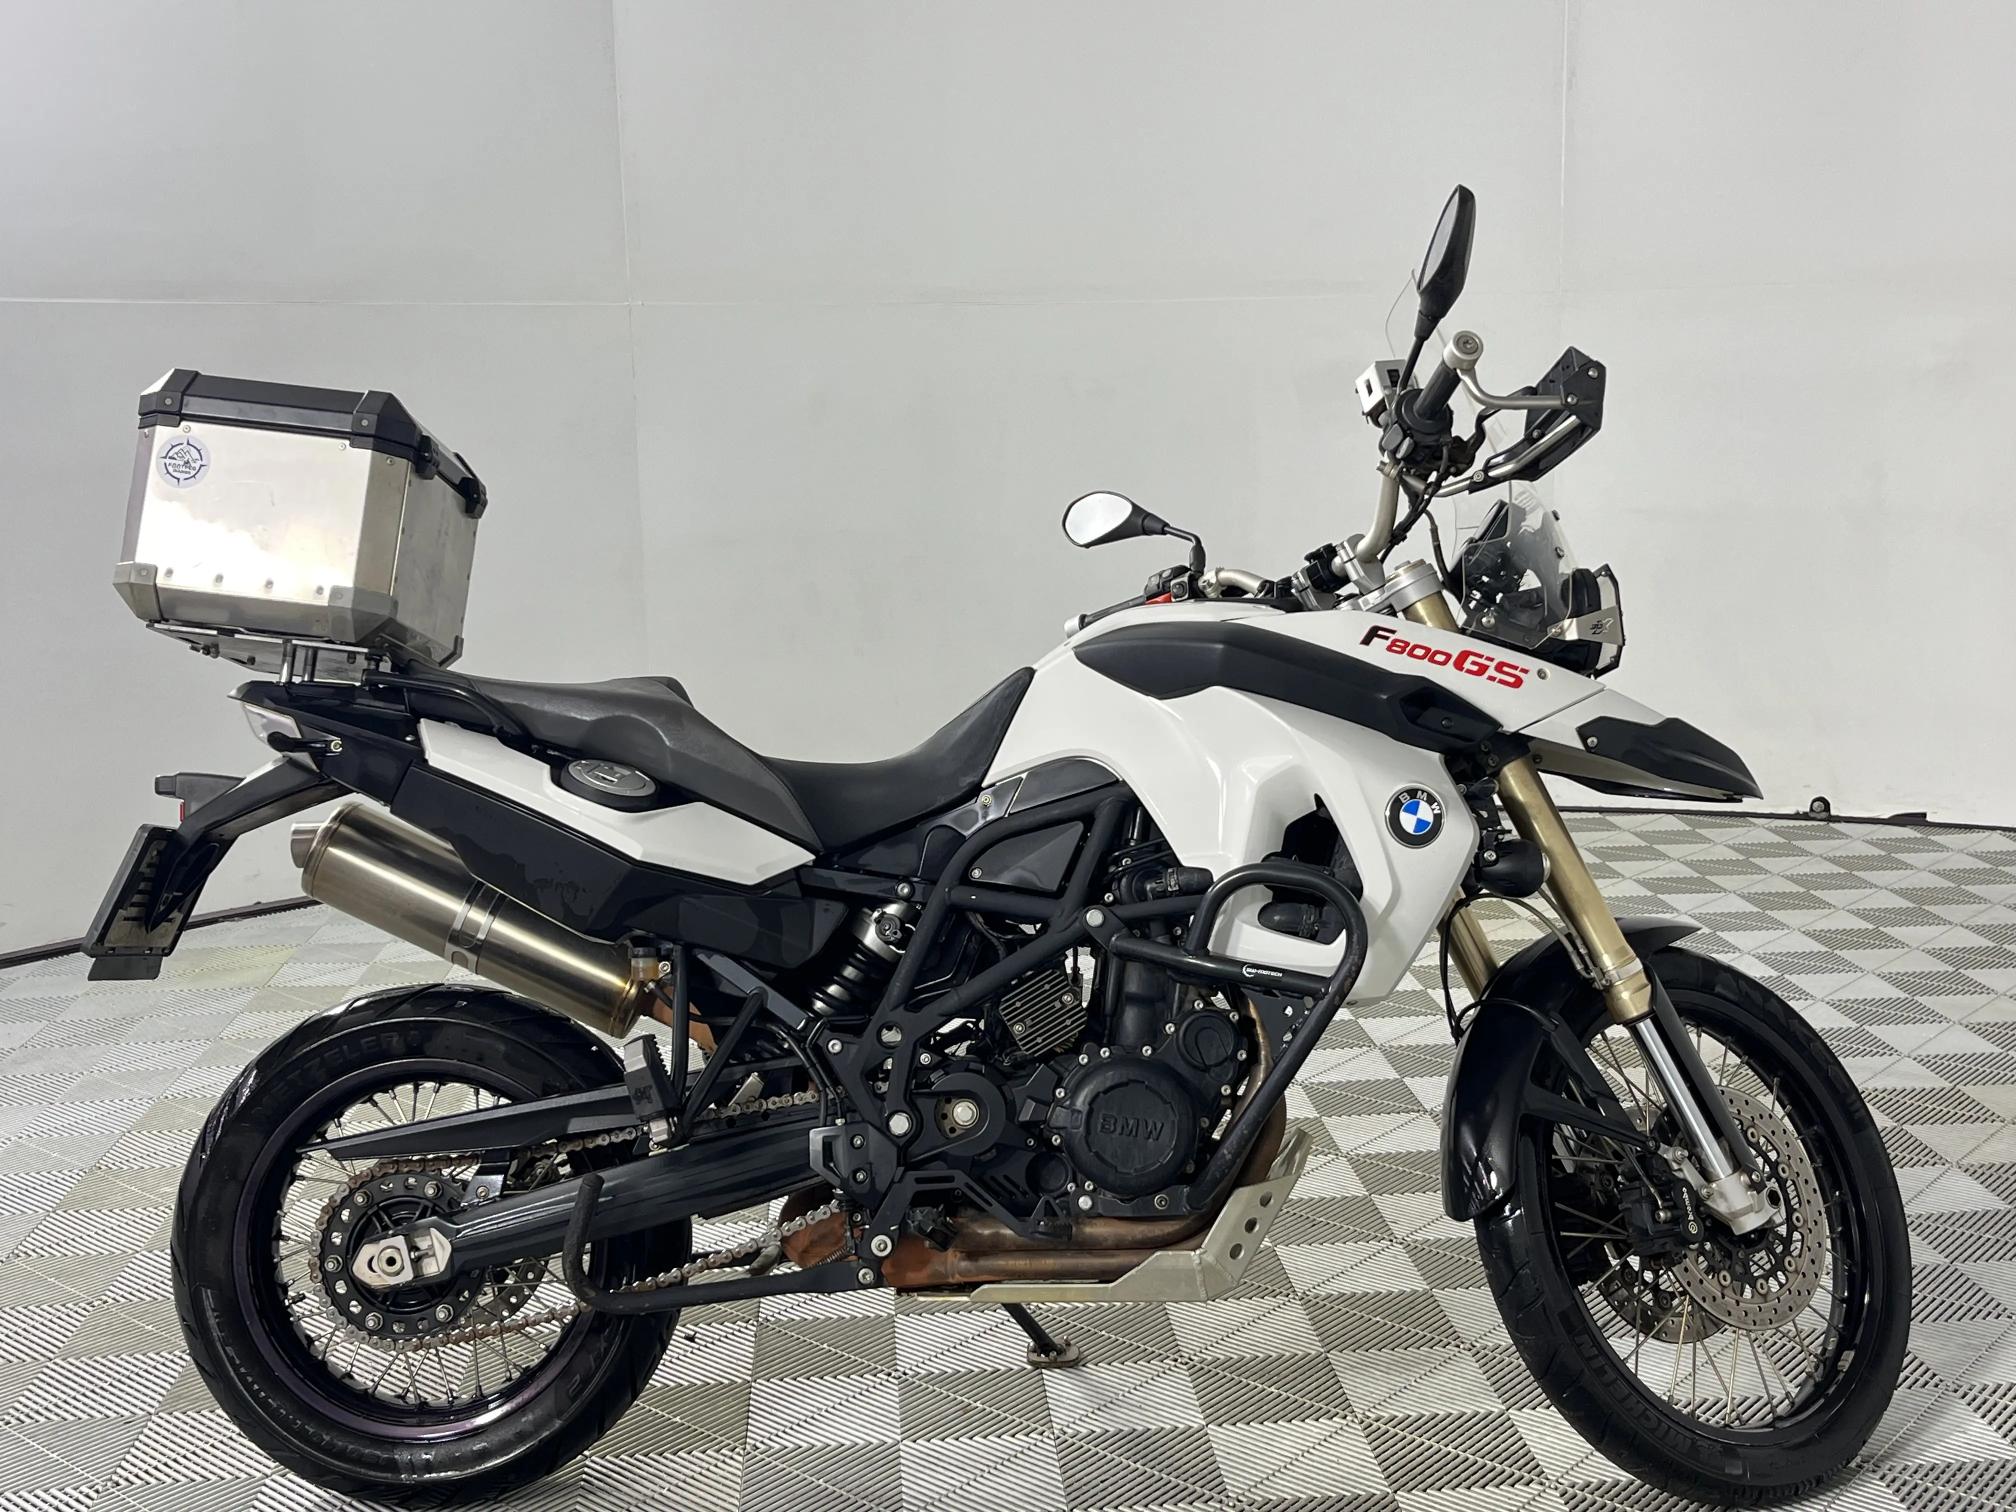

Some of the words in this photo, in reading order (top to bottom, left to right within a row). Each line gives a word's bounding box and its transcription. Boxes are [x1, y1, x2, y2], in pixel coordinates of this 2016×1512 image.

[1398, 790, 1441, 814] BMW
[1098, 1113, 1165, 1142] BMW
[1682, 1187, 1694, 1220] brembo
[1573, 1333, 1694, 1453] MICHELIN
